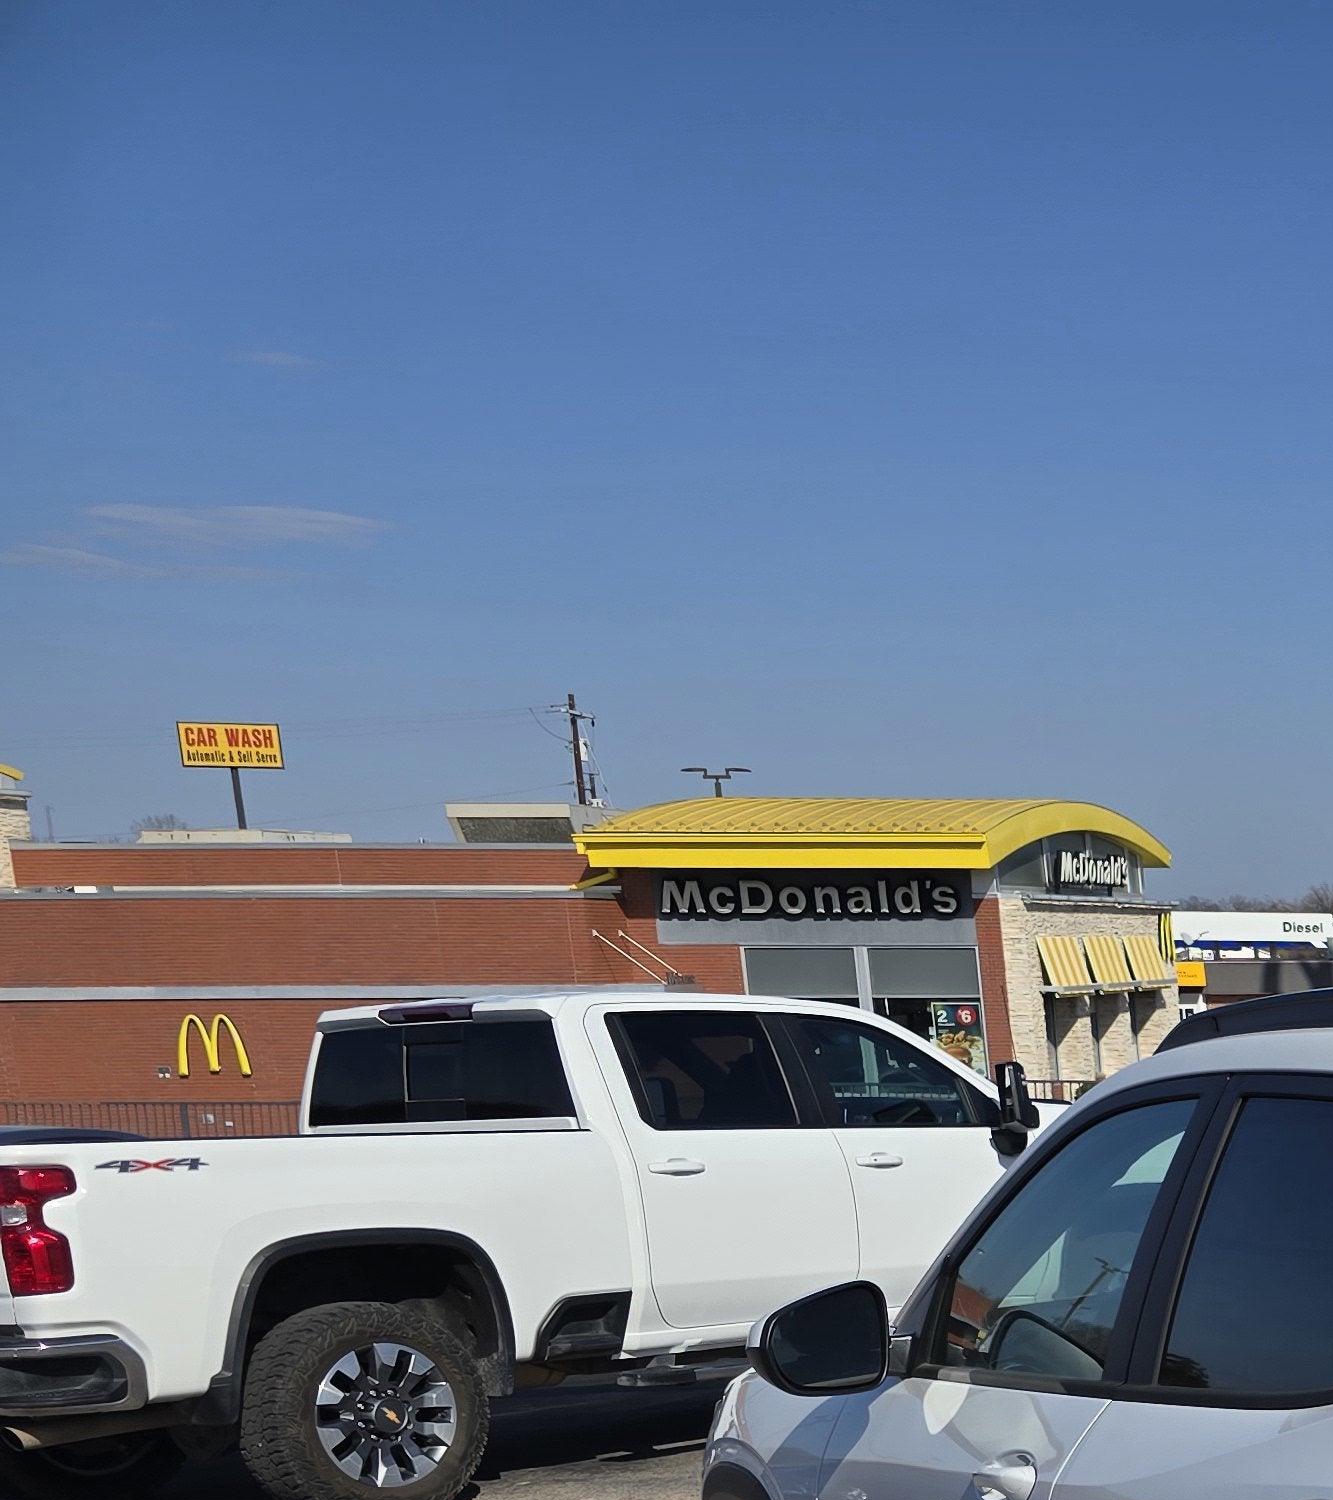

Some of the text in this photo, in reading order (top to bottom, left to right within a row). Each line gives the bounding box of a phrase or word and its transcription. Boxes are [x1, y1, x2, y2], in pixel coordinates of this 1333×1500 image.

[184, 727, 274, 748] CAR WASH
[187, 750, 278, 763] Automatic & Self Serve
[1060, 851, 1128, 885] McDonald's
[661, 880, 957, 914] McDonald's
[1282, 921, 1324, 933] Diesel
[936, 1010, 948, 1023] 2
